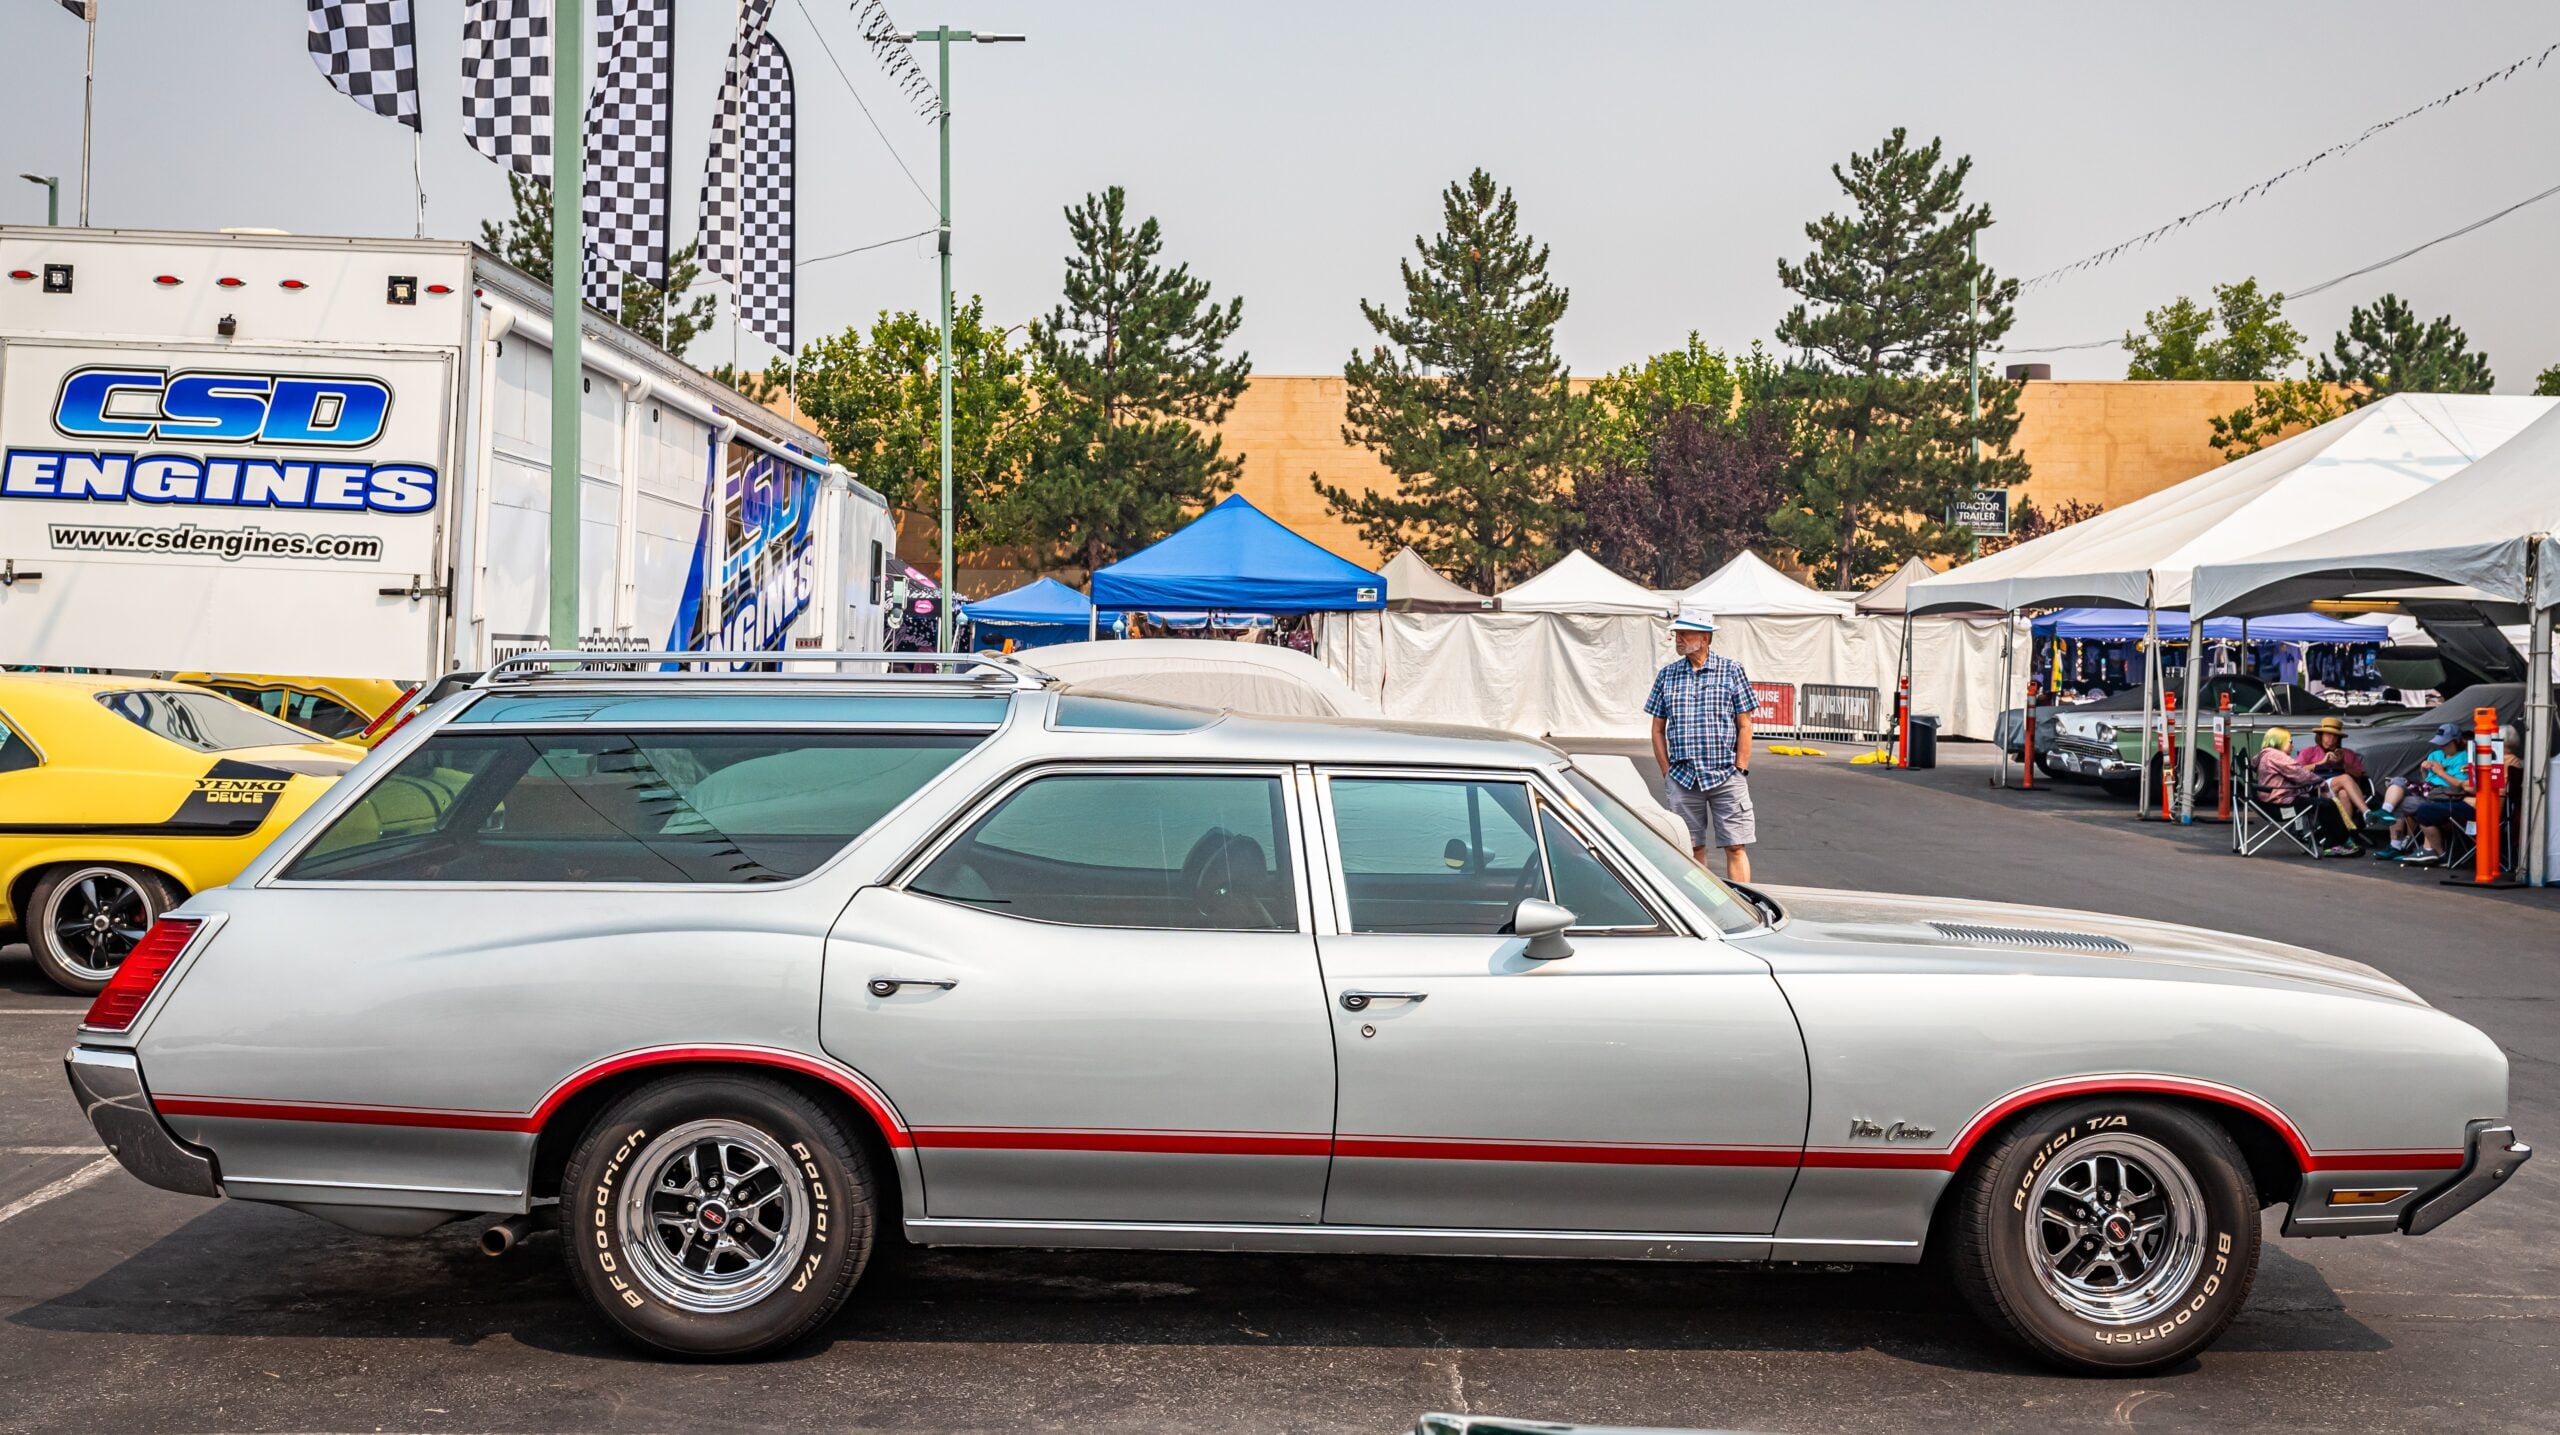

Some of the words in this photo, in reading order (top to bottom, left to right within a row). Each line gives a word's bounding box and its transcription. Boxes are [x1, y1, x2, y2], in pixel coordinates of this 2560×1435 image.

[53, 366, 391, 448] CSD
[2, 450, 437, 512] ENGINES
[1956, 501, 2000, 511] TRACTOR
[1958, 511, 1996, 521] TRAILER
[54, 527, 378, 557] www.csdengines.com
[692, 545, 814, 671] NGINES
[1753, 689, 1780, 703] RUISE
[195, 780, 287, 791] YENKO
[206, 791, 264, 804] DEUCE
[2013, 1127, 2075, 1212] Radial
[2087, 1115, 2128, 1131] T/A
[792, 1141, 829, 1243] Radial
[595, 1128, 646, 1309] BFGoodrich
[791, 1253, 822, 1293] T/A
[2095, 1231, 2232, 1345] BFGoodrich
